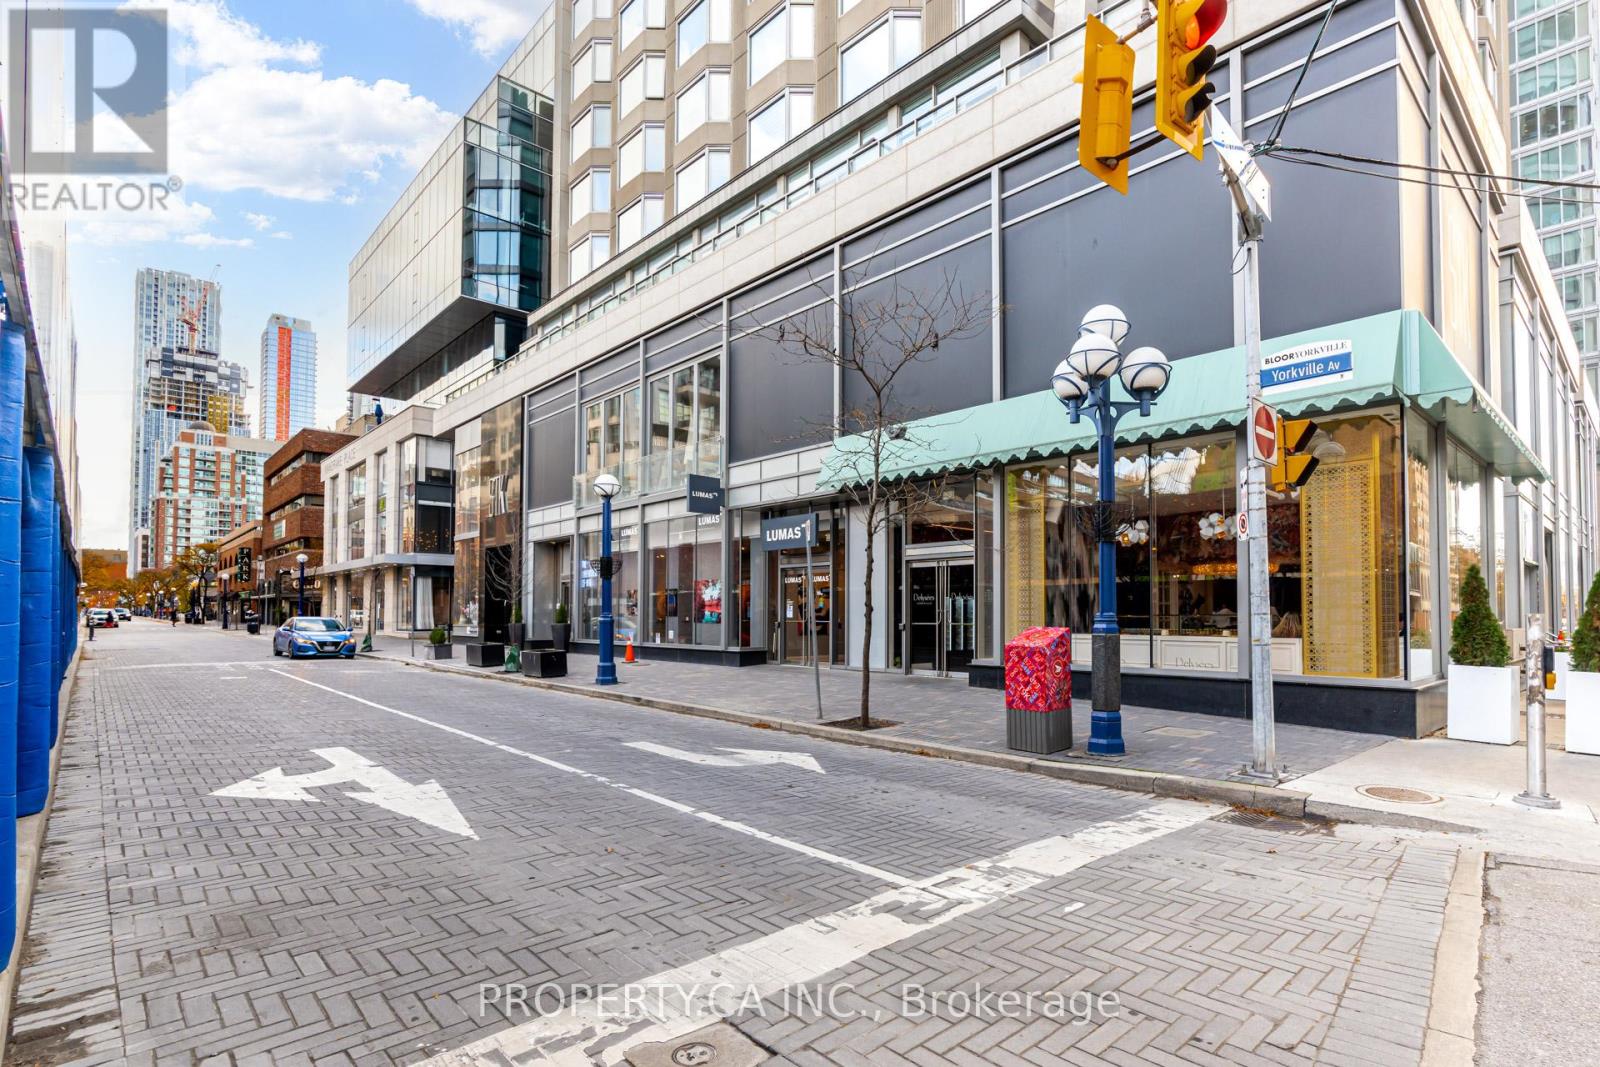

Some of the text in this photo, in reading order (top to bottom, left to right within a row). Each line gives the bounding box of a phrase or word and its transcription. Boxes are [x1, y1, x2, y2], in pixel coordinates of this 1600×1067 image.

[1272, 361, 1340, 381] Yorkville Av
[692, 490, 714, 499] LUMAS
[698, 514, 720, 526] LUMAS
[766, 526, 801, 542] LUMAS
